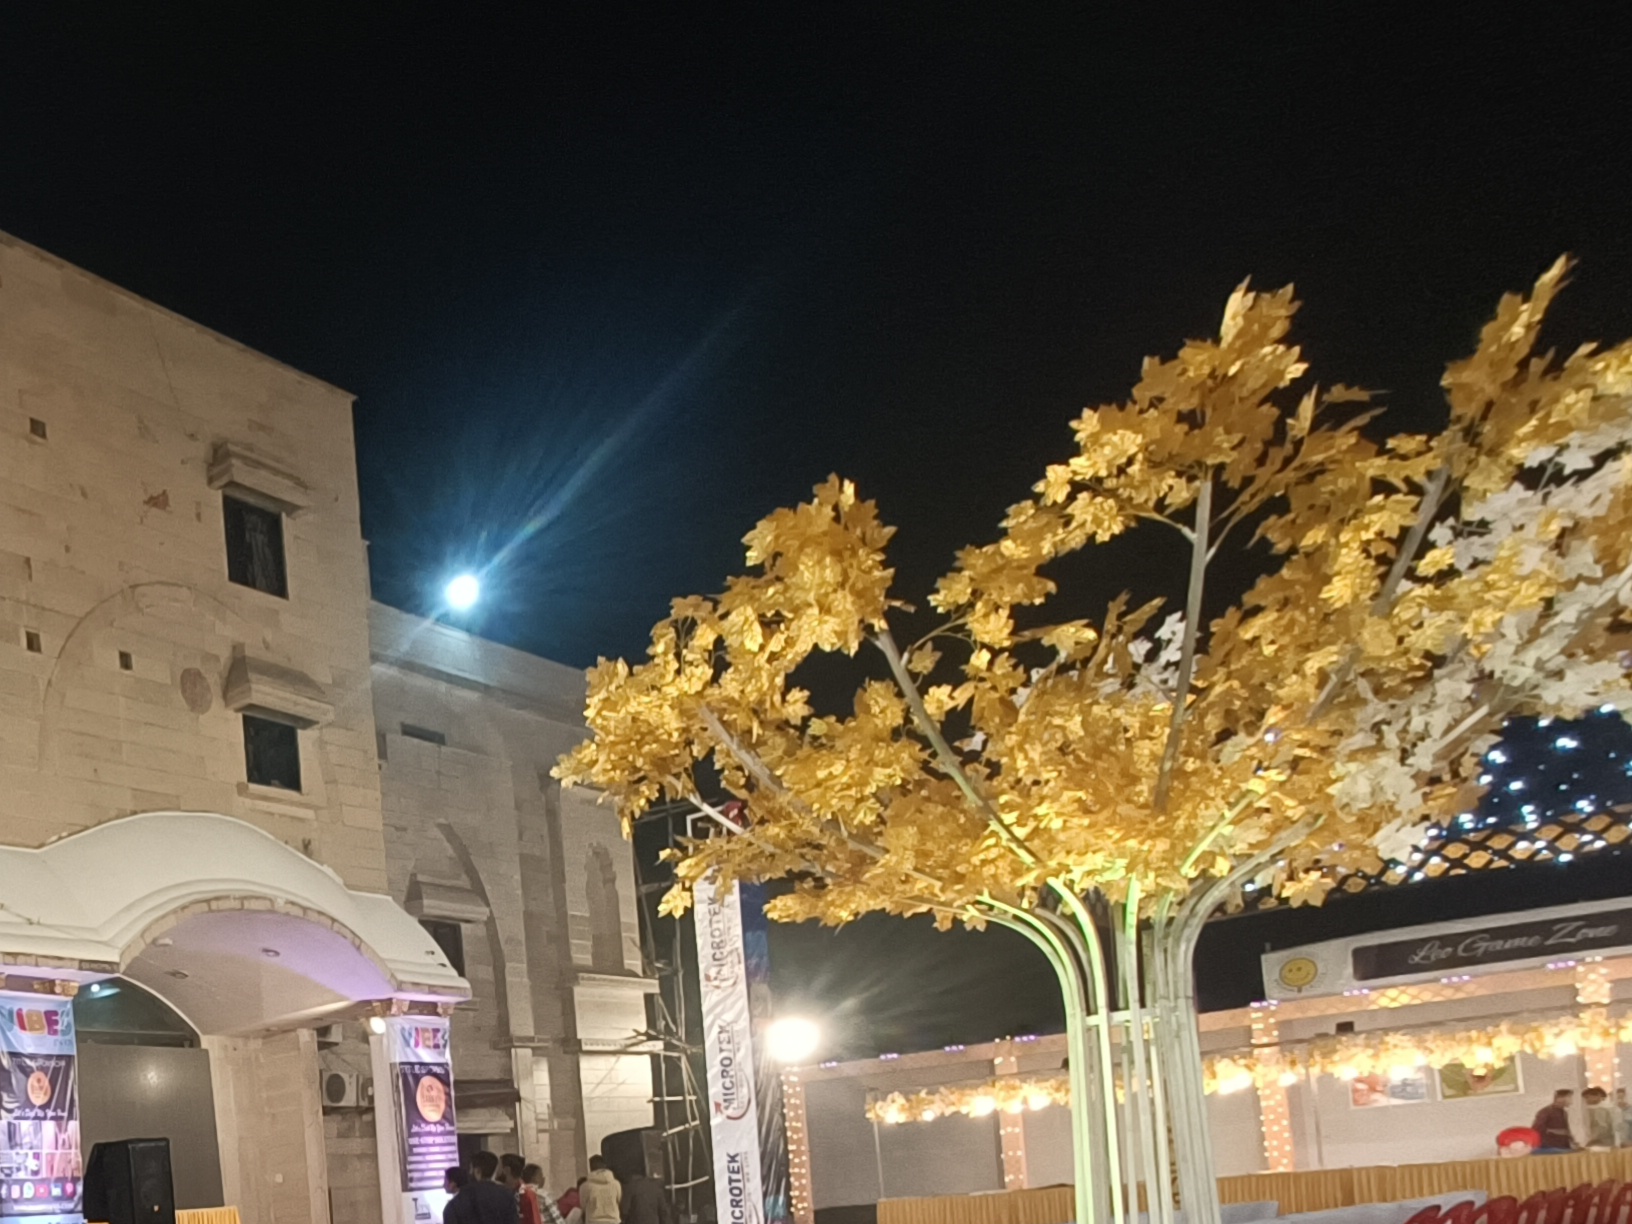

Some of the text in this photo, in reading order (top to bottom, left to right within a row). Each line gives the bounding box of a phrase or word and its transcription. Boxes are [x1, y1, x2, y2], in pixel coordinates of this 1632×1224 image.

[1408, 921, 1618, 965] Leo Game Zone
